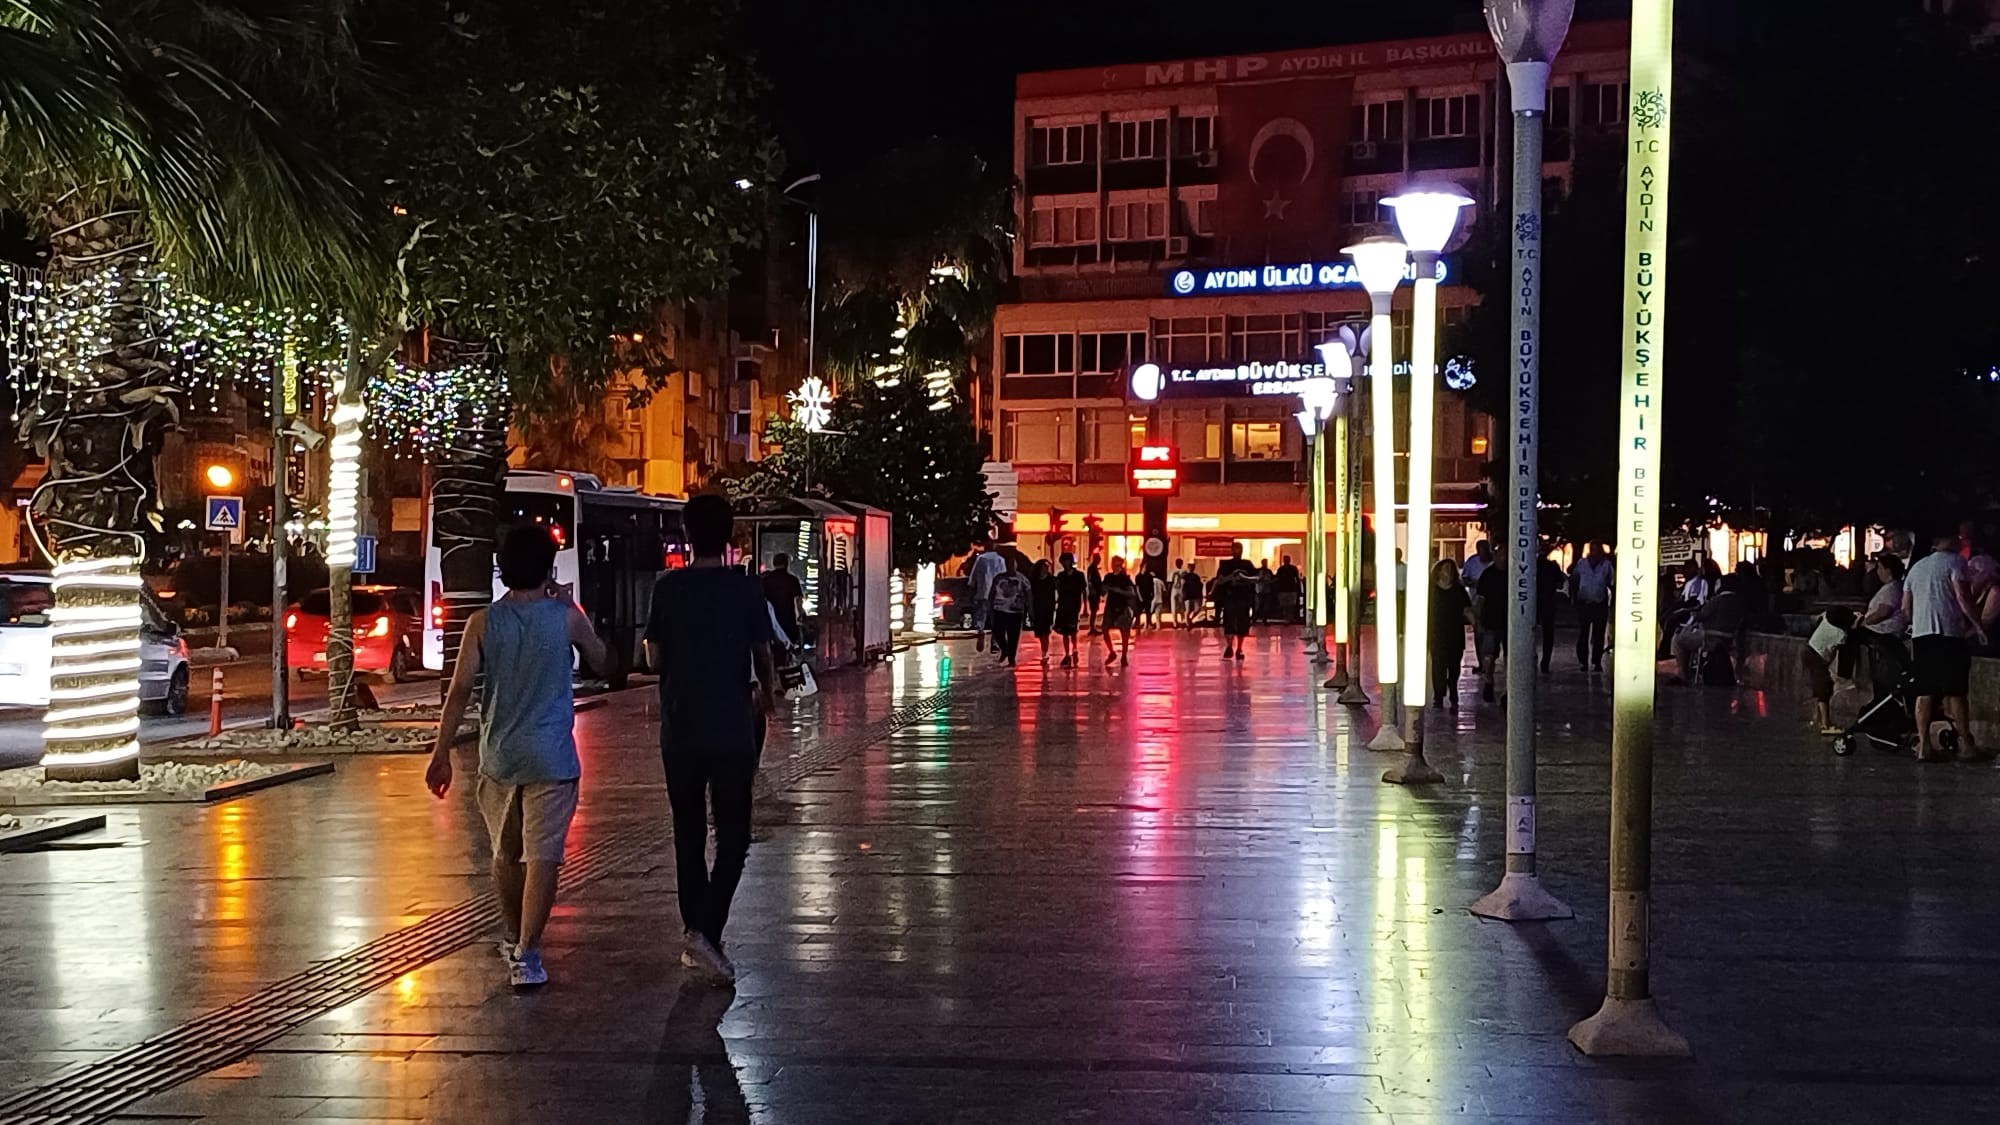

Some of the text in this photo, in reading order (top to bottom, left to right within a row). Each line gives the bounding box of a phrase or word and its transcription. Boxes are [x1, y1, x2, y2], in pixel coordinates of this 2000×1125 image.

[1145, 57, 1269, 86] MHP
[1280, 54, 1343, 72] AYDIN
[1640, 165, 1654, 232] AYDIN
[1204, 262, 1416, 290] AYDIN ÜLKÜ OCARI
[1521, 266, 1533, 316] AYDIN
[1634, 252, 1653, 450] BÜYÜKŞEHİR
